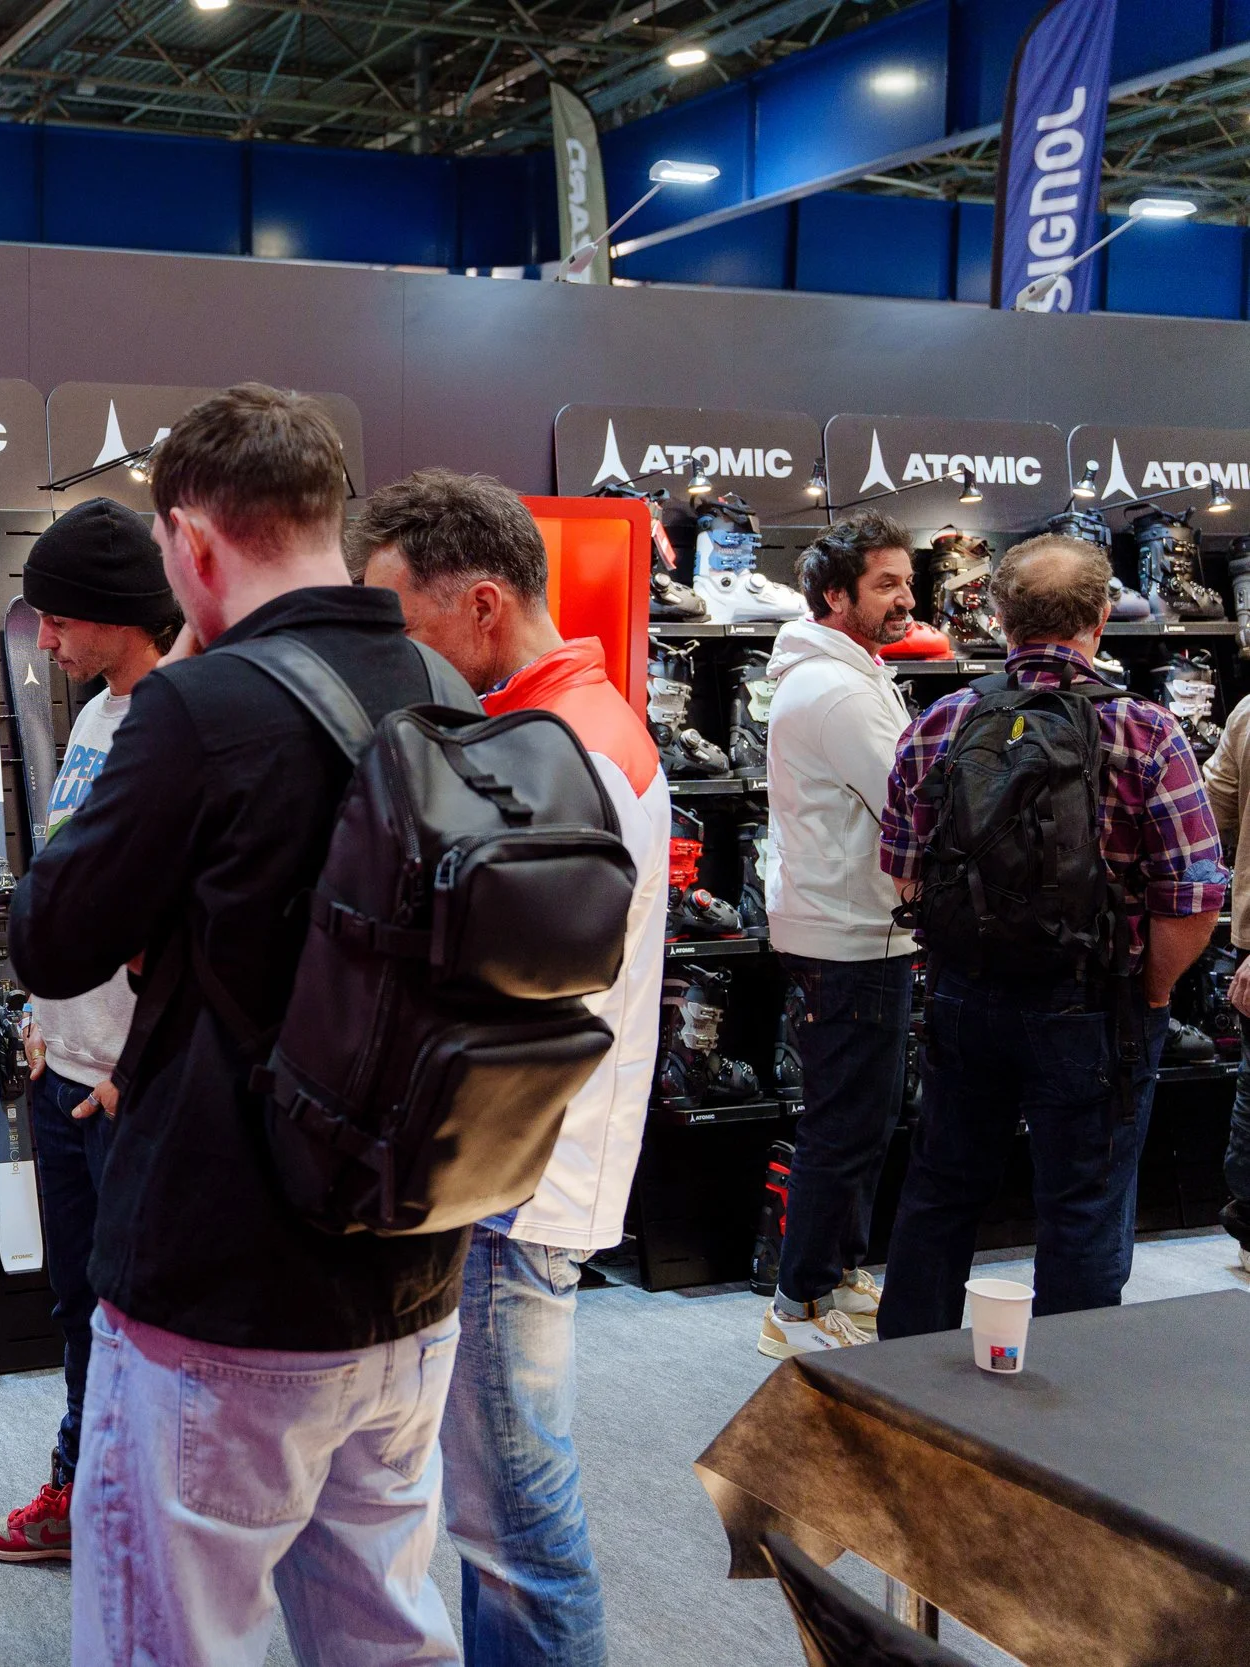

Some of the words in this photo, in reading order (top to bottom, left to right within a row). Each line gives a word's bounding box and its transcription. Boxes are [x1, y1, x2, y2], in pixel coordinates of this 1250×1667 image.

[639, 444, 793, 479] ATOMIC
[902, 453, 1042, 486] ATOMIC
[1141, 460, 1250, 490] ATOMI
[58, 743, 109, 781] PER
[695, 1113, 716, 1121] ATOMIC
[11, 1253, 34, 1261] ATOMIC
